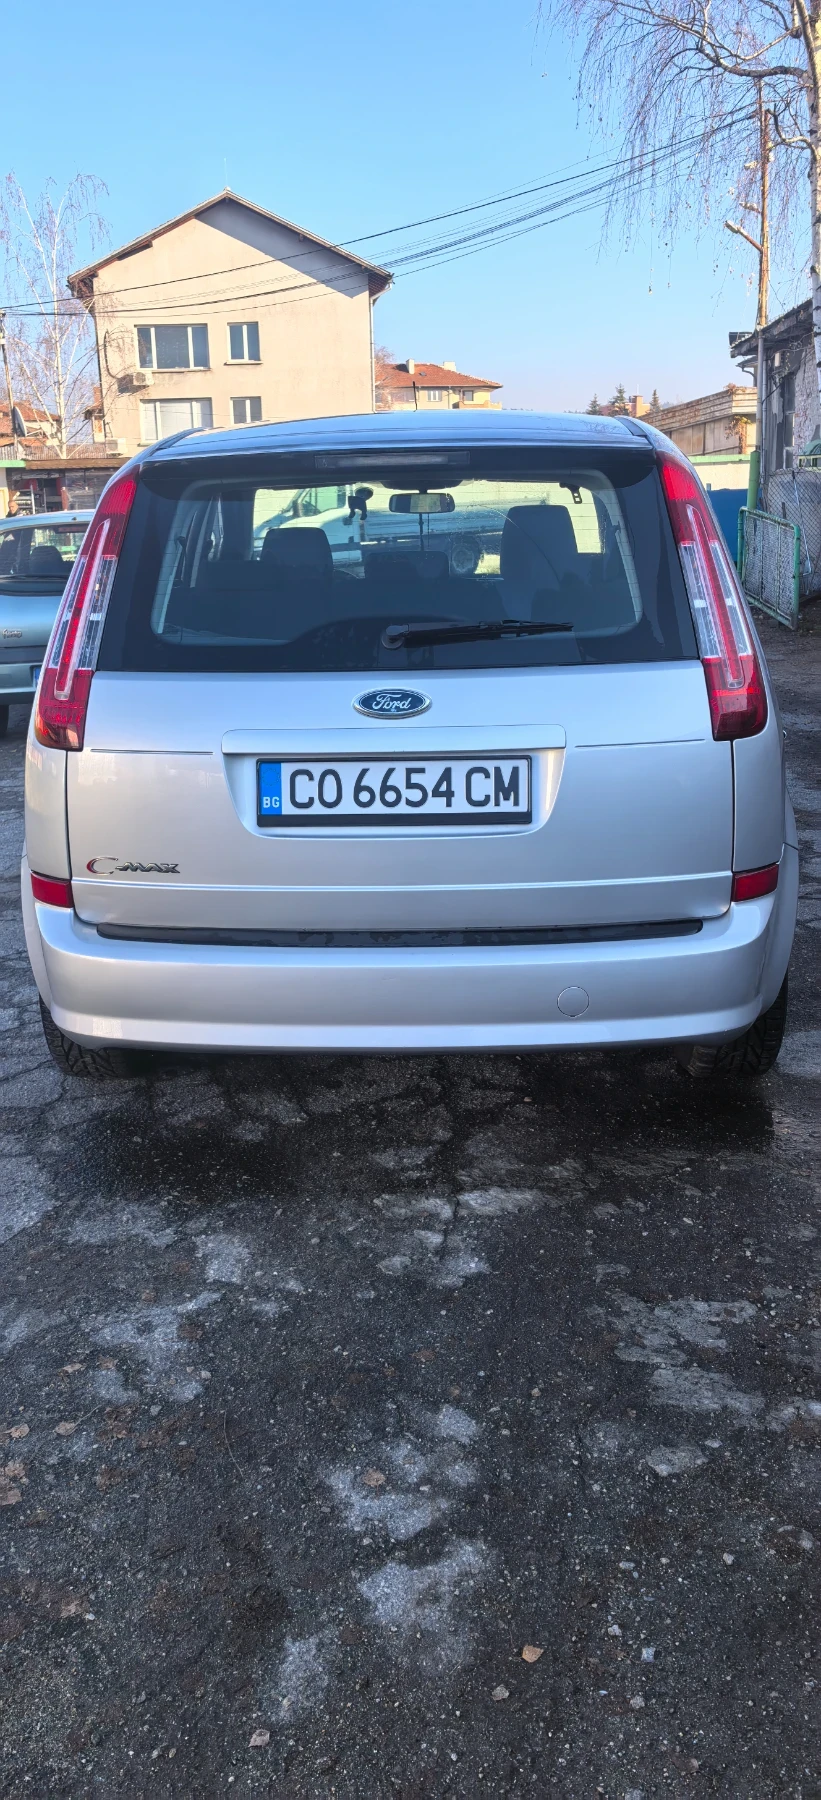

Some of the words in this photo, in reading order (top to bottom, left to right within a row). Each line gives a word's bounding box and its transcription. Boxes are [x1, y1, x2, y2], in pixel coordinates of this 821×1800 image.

[372, 693, 411, 710] Ford
[289, 768, 343, 809] CO
[353, 767, 455, 808] 6654
[465, 766, 520, 807] CM
[263, 796, 280, 808] BG
